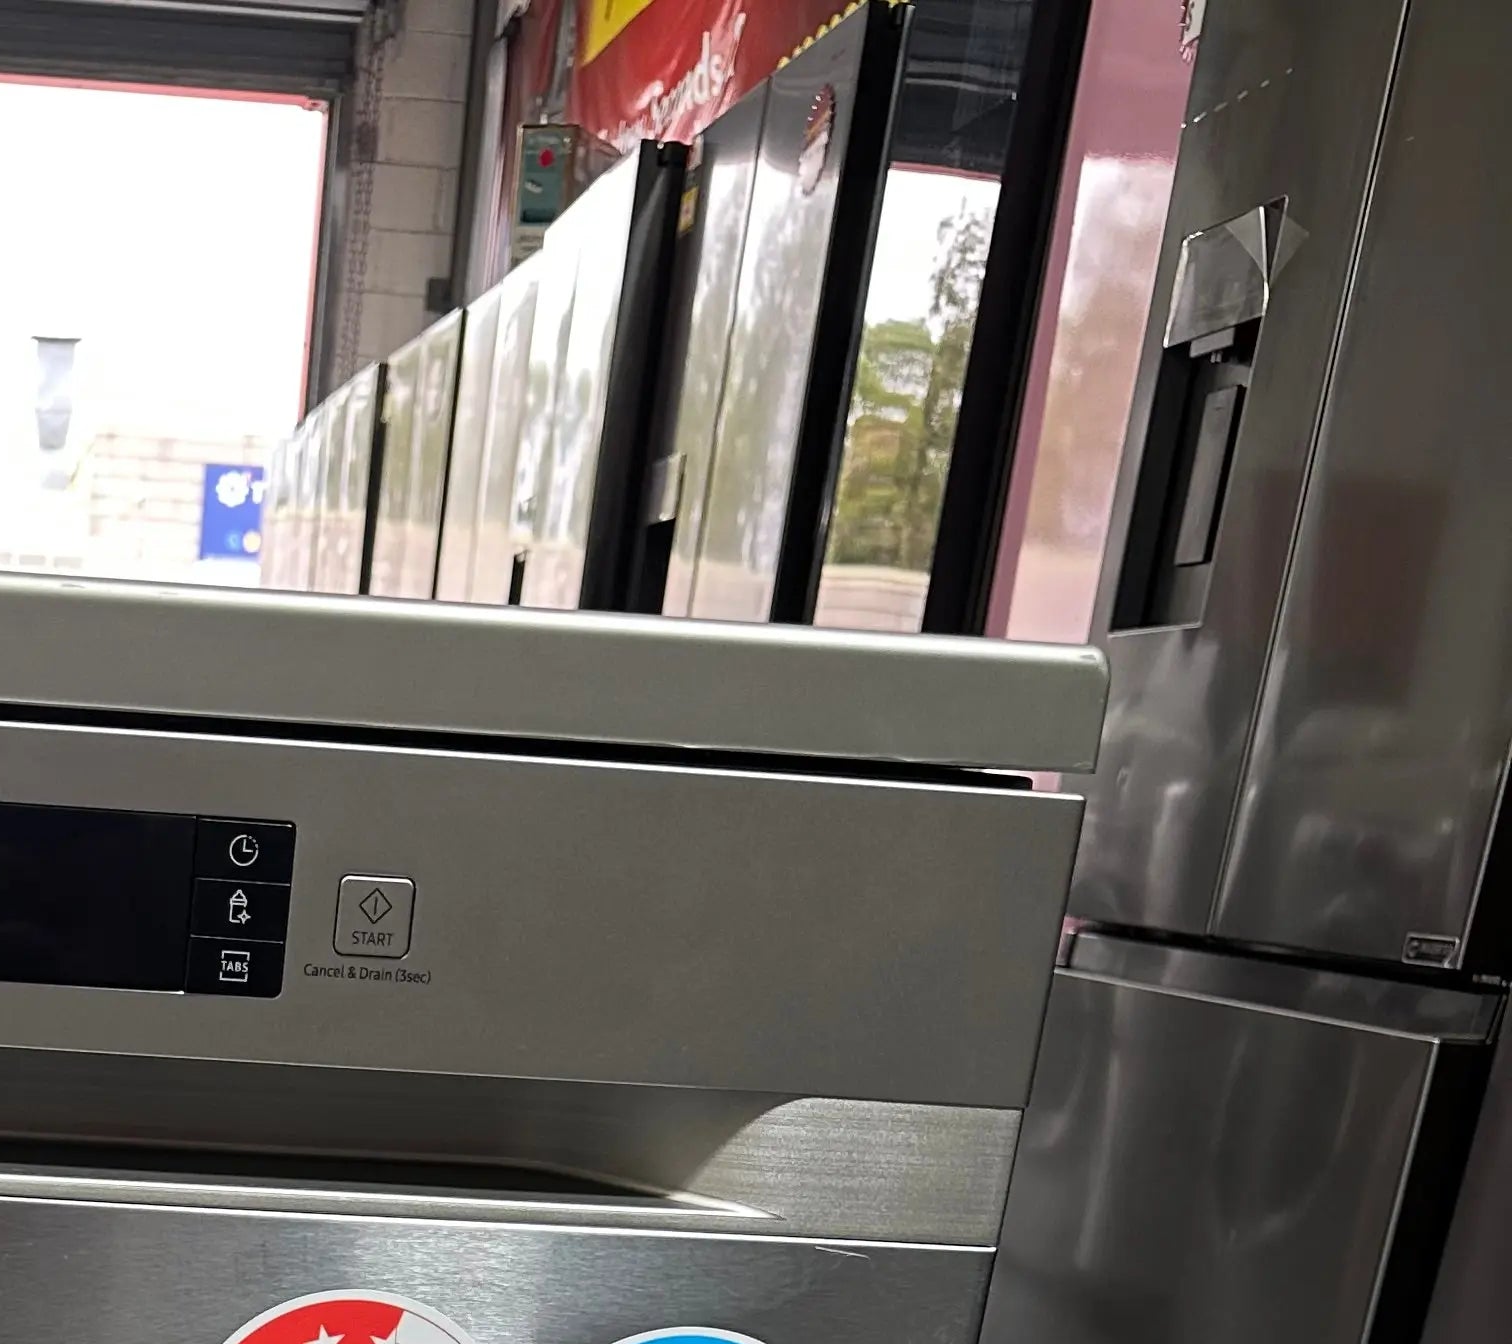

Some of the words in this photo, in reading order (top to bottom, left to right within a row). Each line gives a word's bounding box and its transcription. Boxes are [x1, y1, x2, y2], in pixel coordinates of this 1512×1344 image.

[351, 930, 396, 947] START
[220, 960, 249, 973] TABS
[303, 963, 345, 978] Cancel
[346, 965, 357, 980] &
[359, 966, 393, 982] Drain
[395, 967, 432, 985] (3sec)
